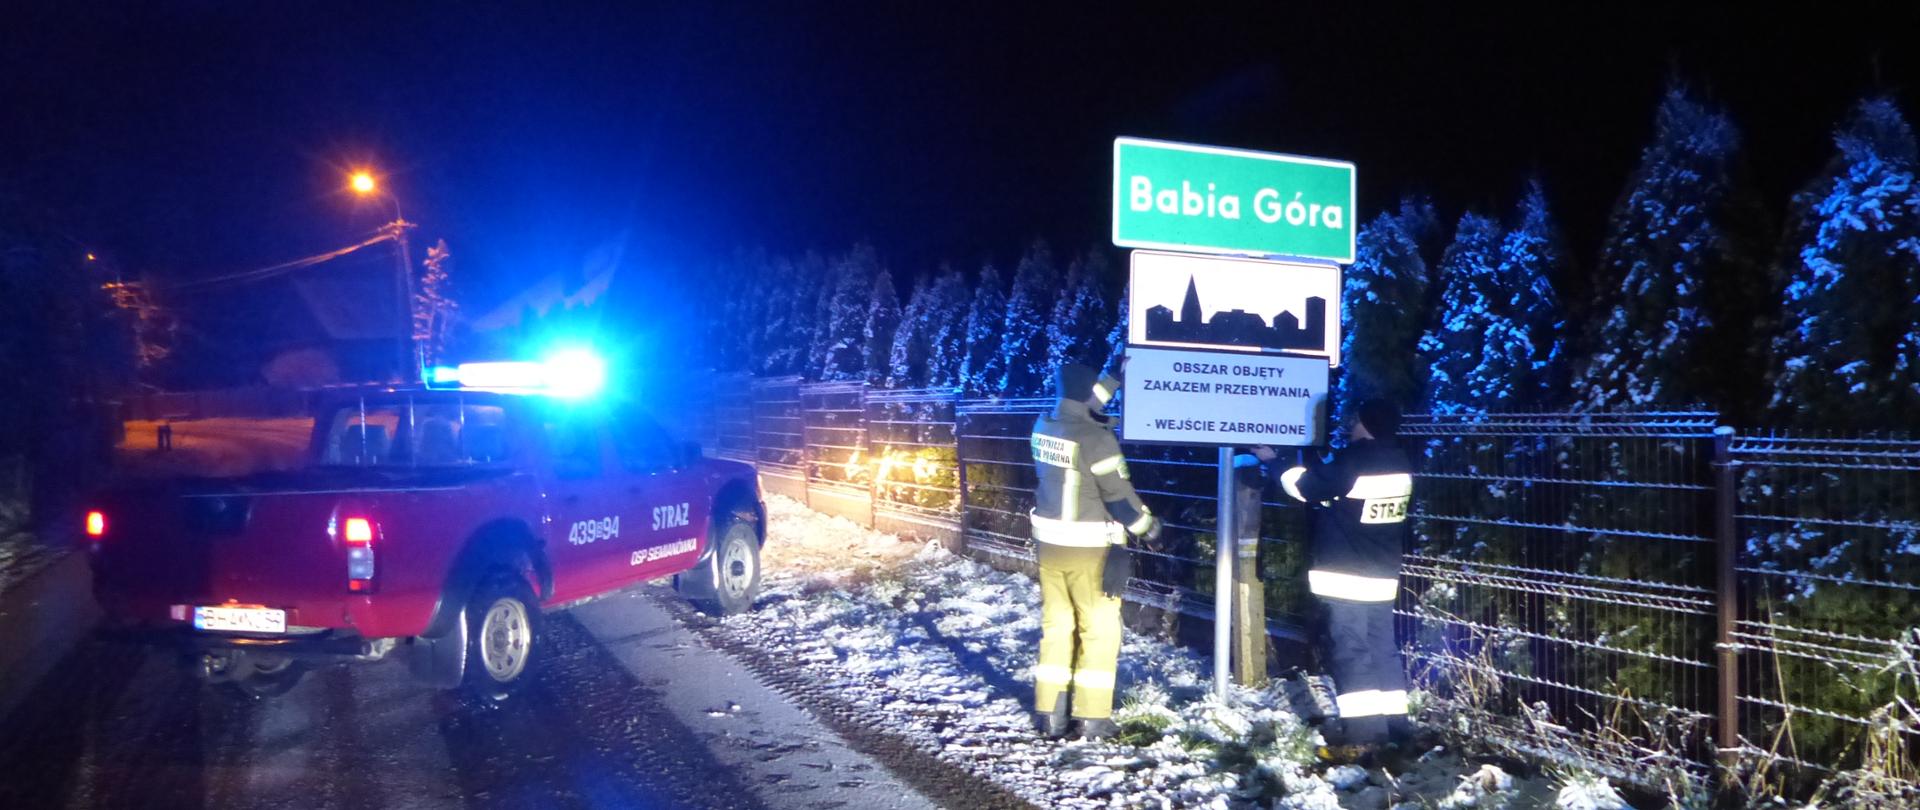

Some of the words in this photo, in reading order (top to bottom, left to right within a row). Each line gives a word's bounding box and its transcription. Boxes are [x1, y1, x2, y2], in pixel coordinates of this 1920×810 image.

[1130, 175, 1240, 220] Babia
[1253, 187, 1343, 230] Góra
[1173, 362, 1228, 377] OBSZAR
[1232, 364, 1285, 380] OBJĘTY
[1143, 379, 1211, 394] ZAKAZEM
[1215, 382, 1311, 399] PRZEBYWANIA
[1155, 417, 1216, 432] WEJŚCIE
[1219, 421, 1307, 436] ZABRONIONE
[630, 549, 649, 566] OSP
